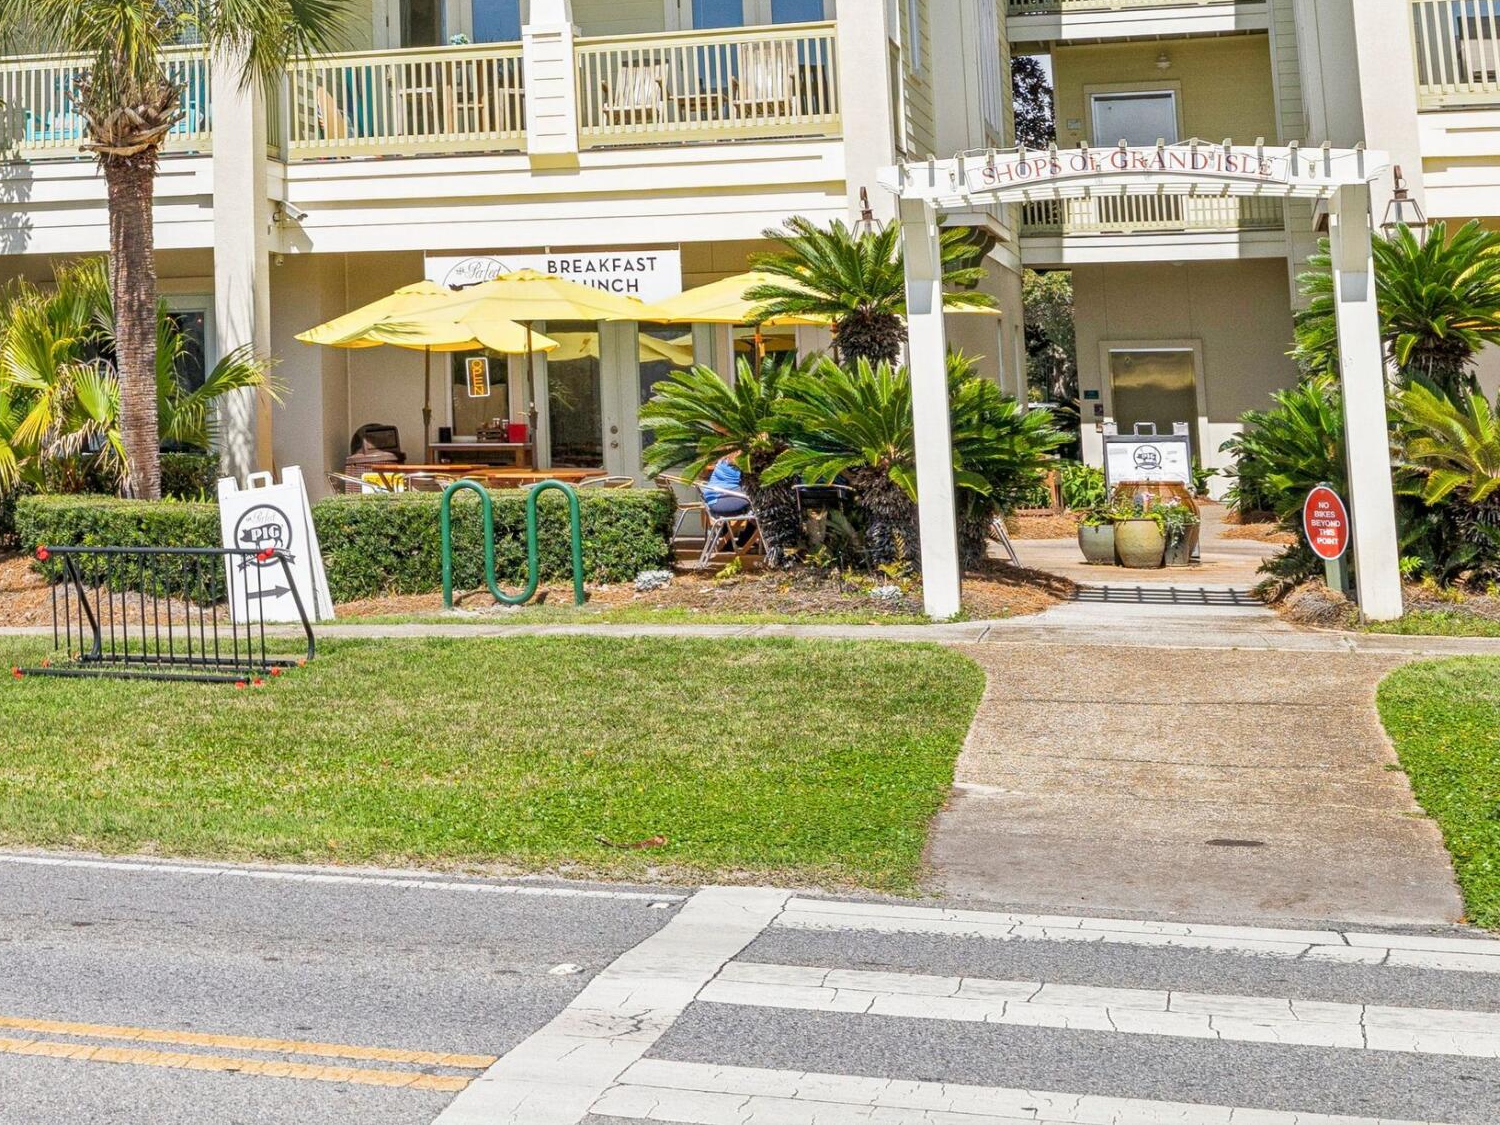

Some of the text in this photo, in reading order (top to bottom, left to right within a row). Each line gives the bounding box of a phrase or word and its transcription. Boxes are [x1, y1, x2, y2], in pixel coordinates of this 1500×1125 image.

[982, 157, 1062, 185] SHOPS
[1110, 150, 1209, 170] GRAND
[1216, 154, 1273, 176] ISLE
[547, 257, 657, 274] BREAKFAST
[1314, 510, 1336, 518] BIKES
[1310, 519, 1341, 527] BEYOND
[250, 525, 280, 541] PIG
